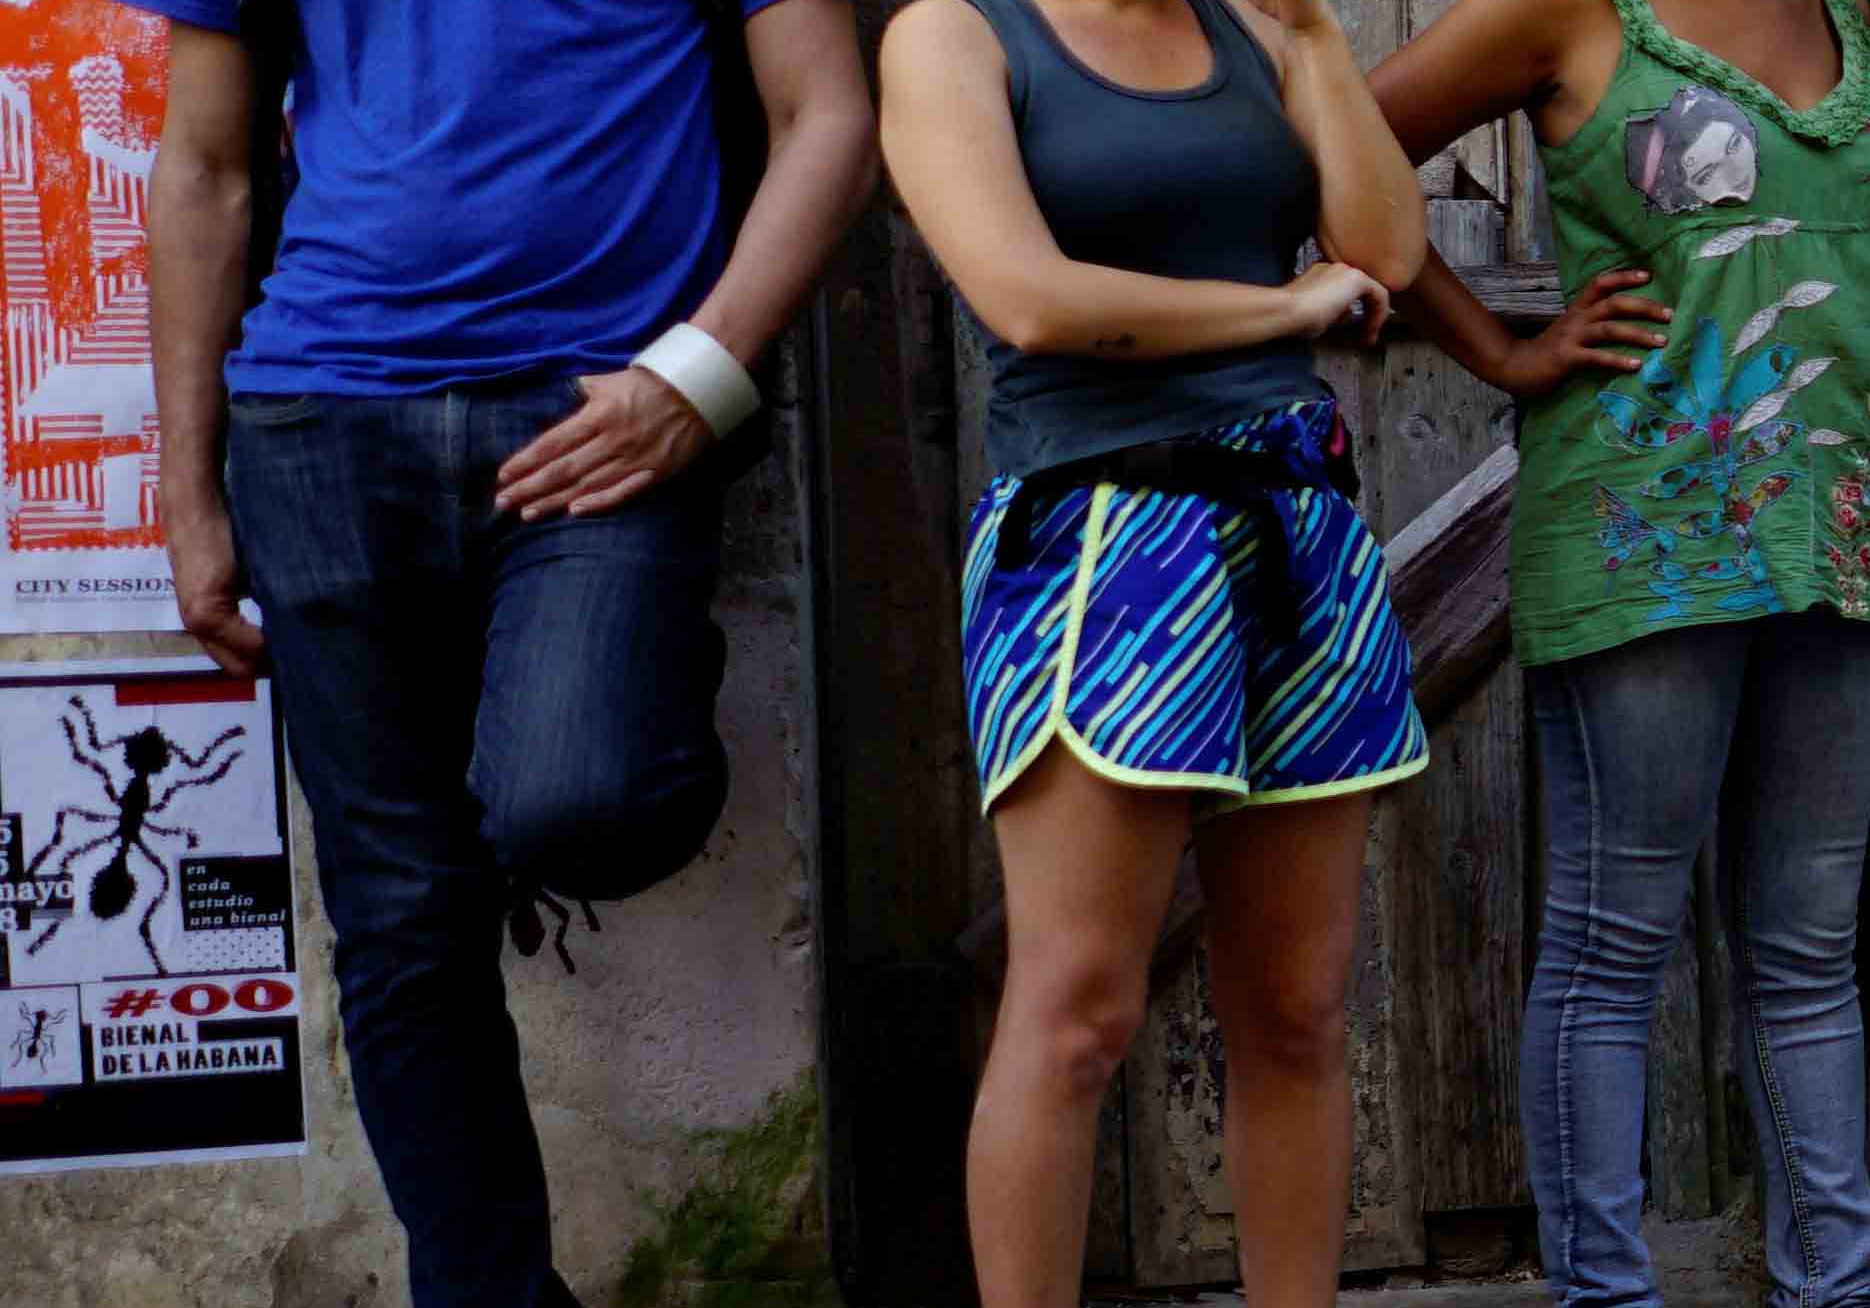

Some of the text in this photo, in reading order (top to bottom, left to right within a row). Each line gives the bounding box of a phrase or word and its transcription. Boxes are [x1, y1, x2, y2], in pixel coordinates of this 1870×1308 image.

[16, 578, 70, 594] CITY
[186, 865, 207, 876] en
[188, 878, 231, 892] cada
[189, 894, 255, 909] estudio
[190, 909, 287, 927] una bienal
[101, 1023, 191, 1048] BIENAL
[102, 1044, 278, 1075] DE LA HABANA
